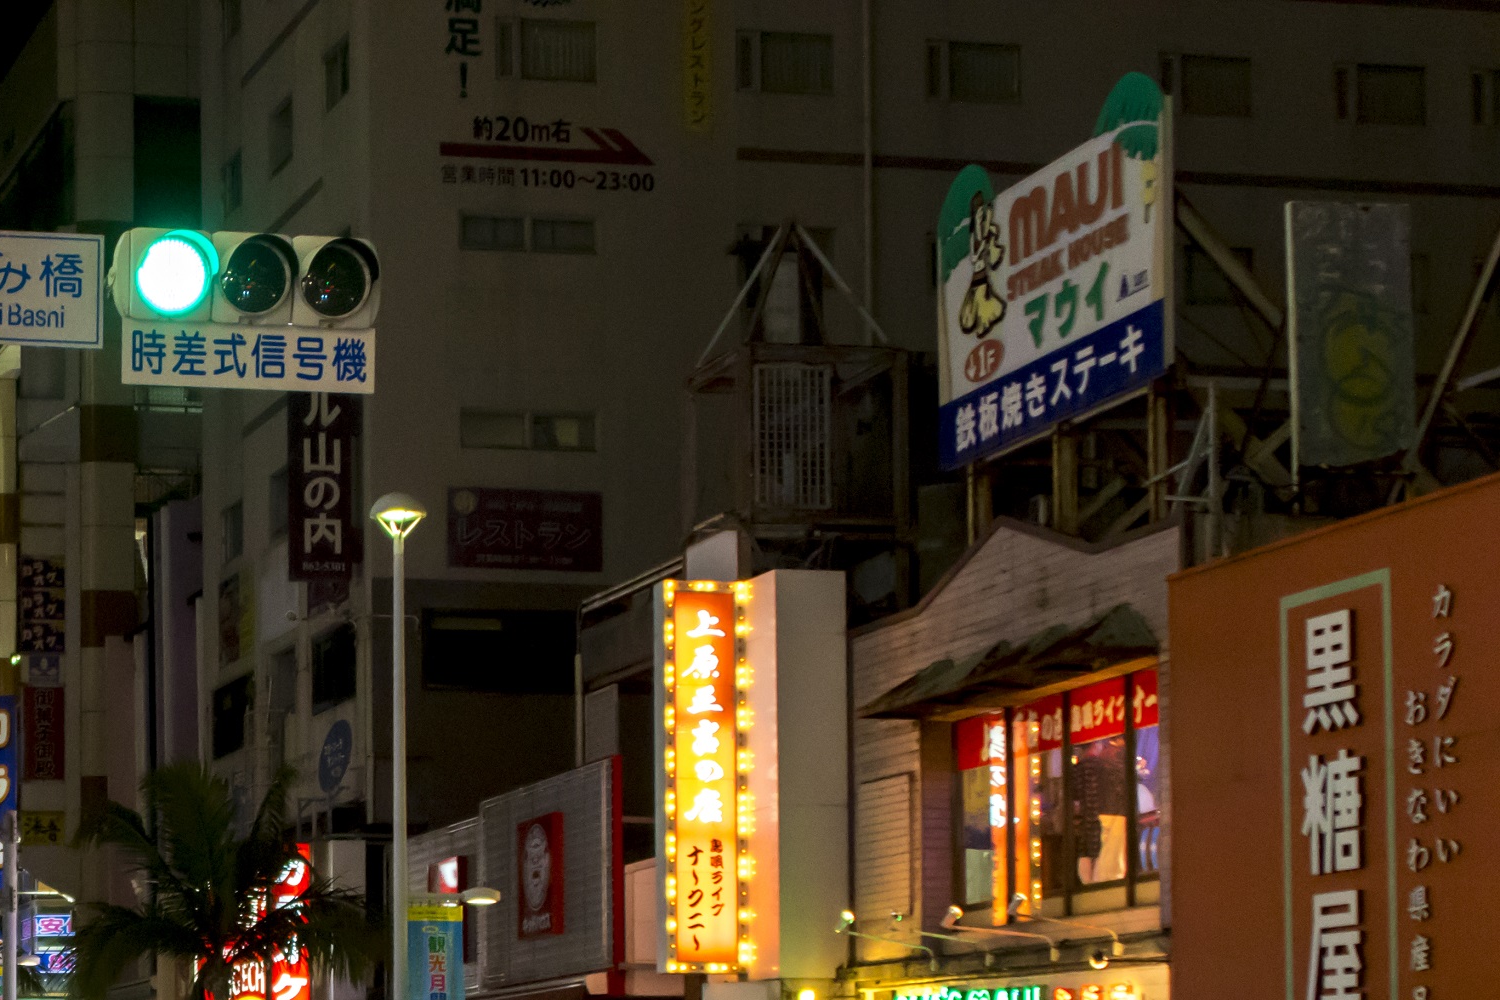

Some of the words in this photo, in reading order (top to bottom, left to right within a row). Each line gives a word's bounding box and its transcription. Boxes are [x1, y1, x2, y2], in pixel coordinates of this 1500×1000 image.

[1009, 141, 1124, 266] MAUI
[131, 329, 367, 383] 時差式信号機
[1025, 261, 1109, 348] マウイ
[955, 324, 1145, 453] 鉄板焼きステーキ
[457, 517, 592, 550] レストラン
[1433, 585, 1461, 864] カラダにいい
